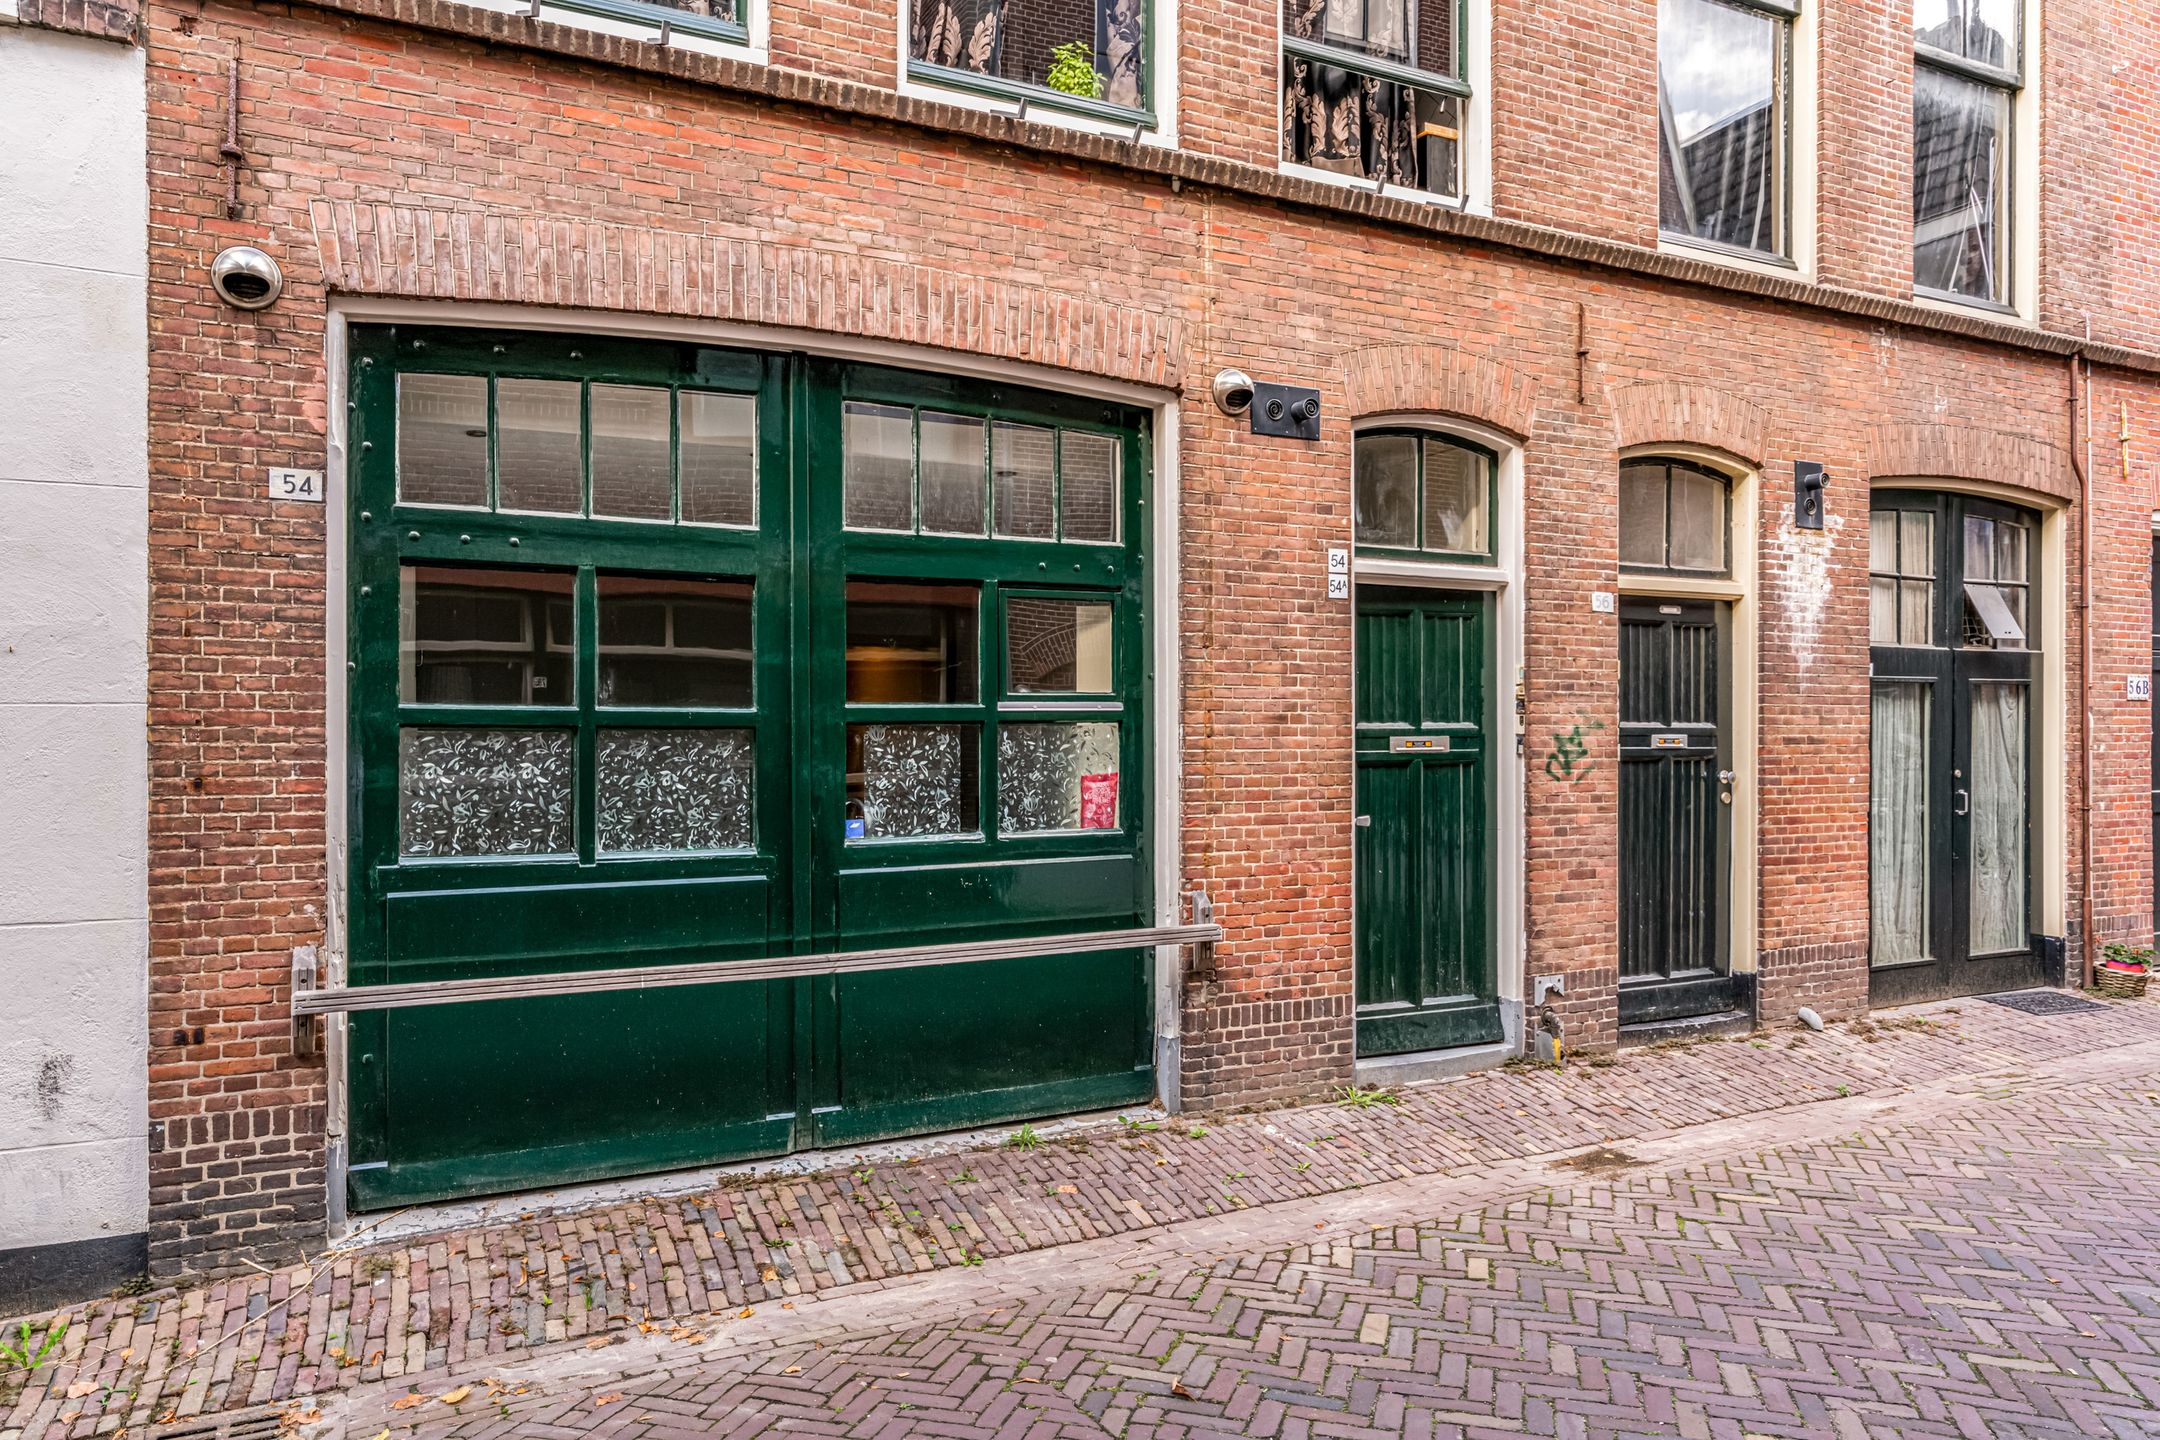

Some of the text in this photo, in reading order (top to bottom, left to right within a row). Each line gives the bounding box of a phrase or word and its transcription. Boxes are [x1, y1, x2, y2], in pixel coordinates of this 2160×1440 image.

[283, 473, 313, 496] 54
[1331, 554, 1346, 568] 54
[1329, 579, 1347, 593] 54A
[1595, 594, 1610, 609] 56
[2128, 680, 2149, 695] 56B
